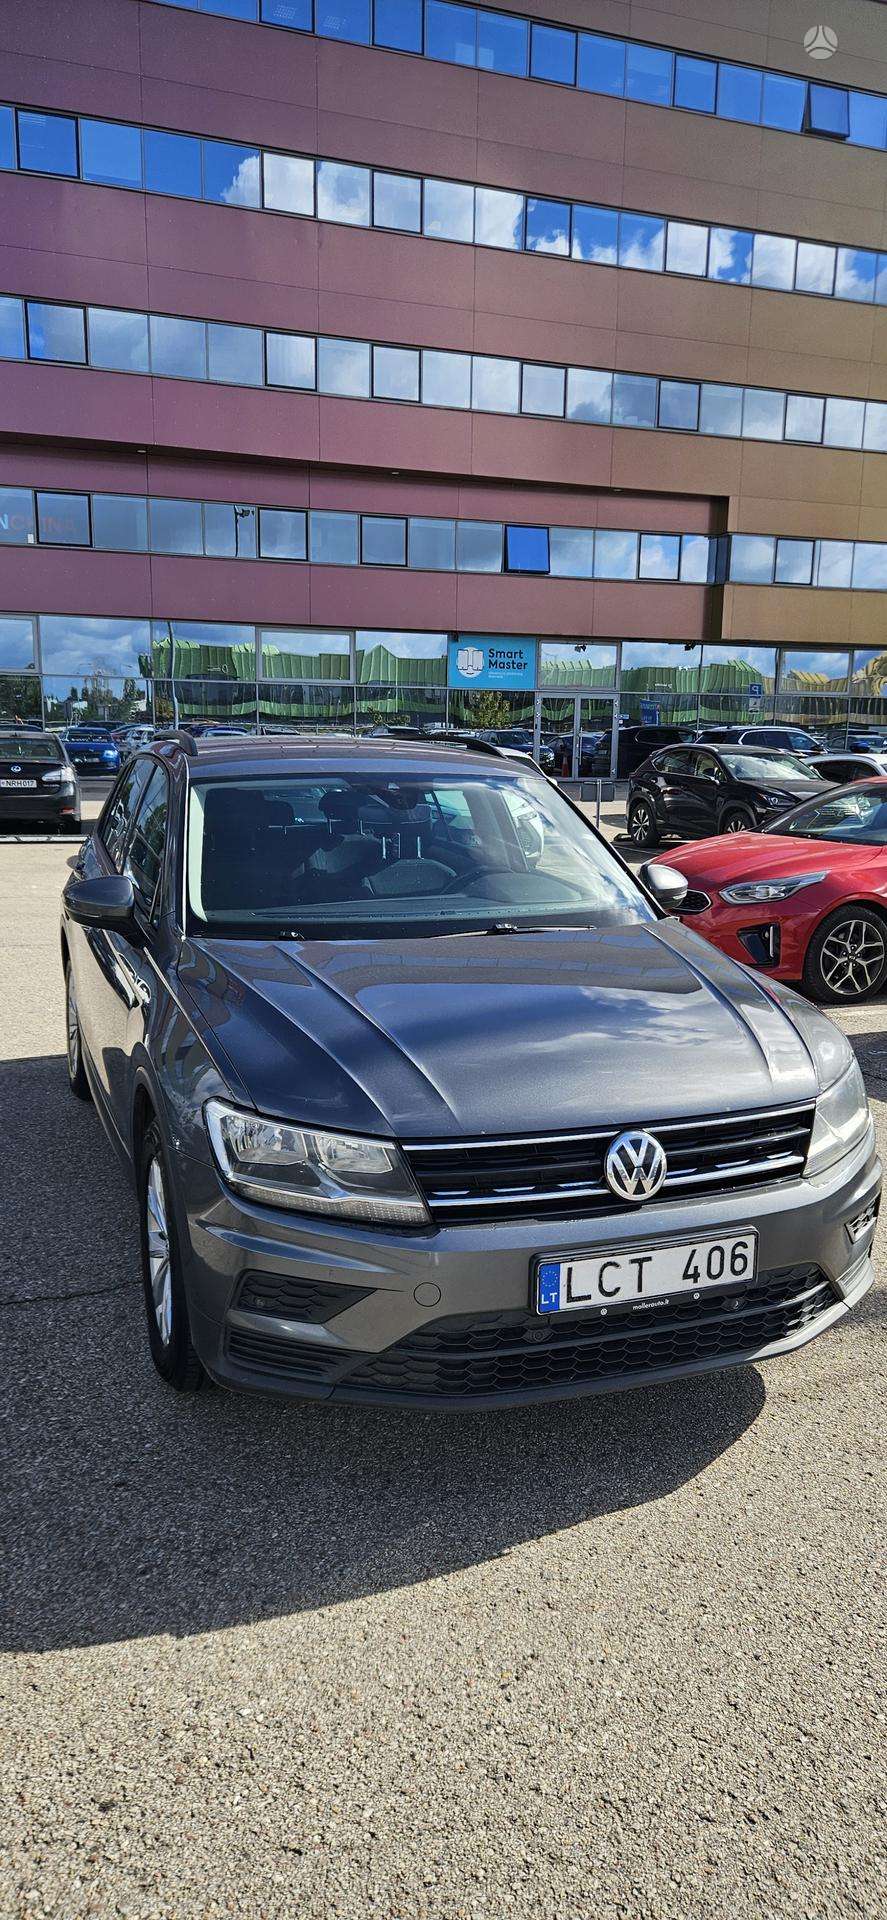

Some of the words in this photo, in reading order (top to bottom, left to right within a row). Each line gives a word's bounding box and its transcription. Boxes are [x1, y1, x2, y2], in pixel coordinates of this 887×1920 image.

[488, 648, 524, 659] Smart
[488, 659, 528, 670] Master
[565, 1256, 653, 1304] LCT
[682, 1241, 749, 1284] 406
[541, 1292, 558, 1305] LT
